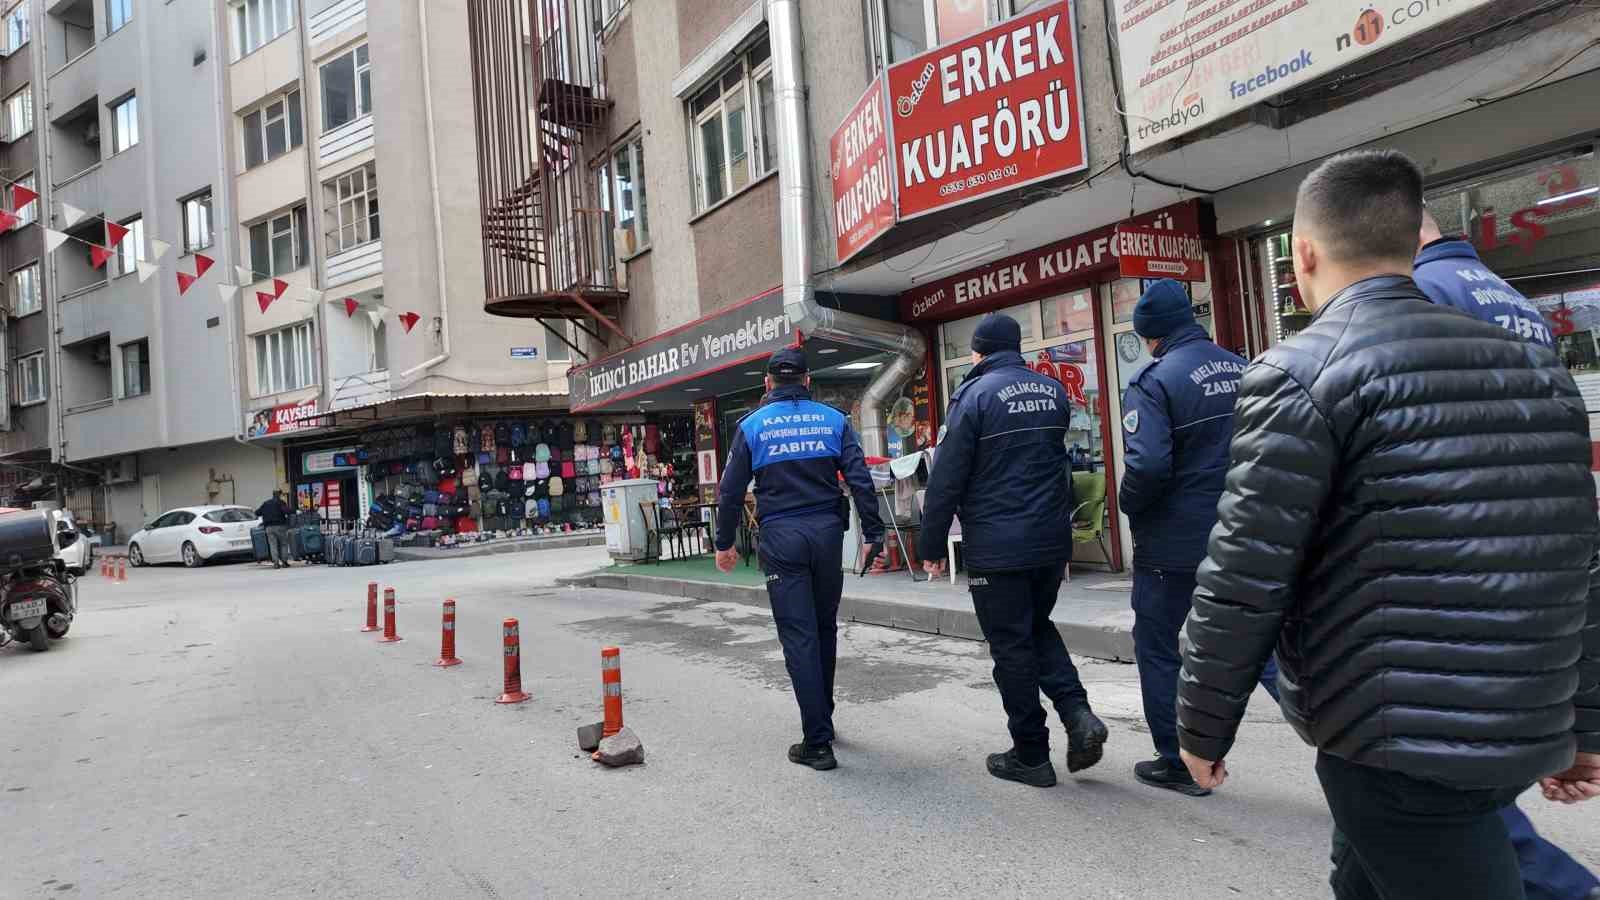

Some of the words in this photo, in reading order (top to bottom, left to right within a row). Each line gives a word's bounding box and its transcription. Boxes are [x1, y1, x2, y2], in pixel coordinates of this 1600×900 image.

[897, 62, 935, 117] Özkan
[938, 15, 1064, 104] ERKEK
[1229, 49, 1312, 99] facebook
[844, 90, 883, 168] ERKEK
[902, 79, 1071, 188] KUAFÖRÜ
[1137, 98, 1205, 140] trendyol
[836, 148, 888, 238] KUAFÖRÜ
[1121, 231, 1158, 256] ERKEK
[1158, 232, 1204, 260] KUAFÖRÜ
[912, 288, 945, 318] Özkan
[954, 262, 1029, 304] ERKEK
[590, 360, 628, 398] İKİNCİ
[629, 347, 680, 385] BAHAR
[681, 342, 699, 368] Ev
[701, 312, 791, 360] Yemekleri
[1024, 351, 1088, 406] ÖR
[1007, 398, 1057, 414] ZABITA
[768, 440, 827, 457] ZABITA
